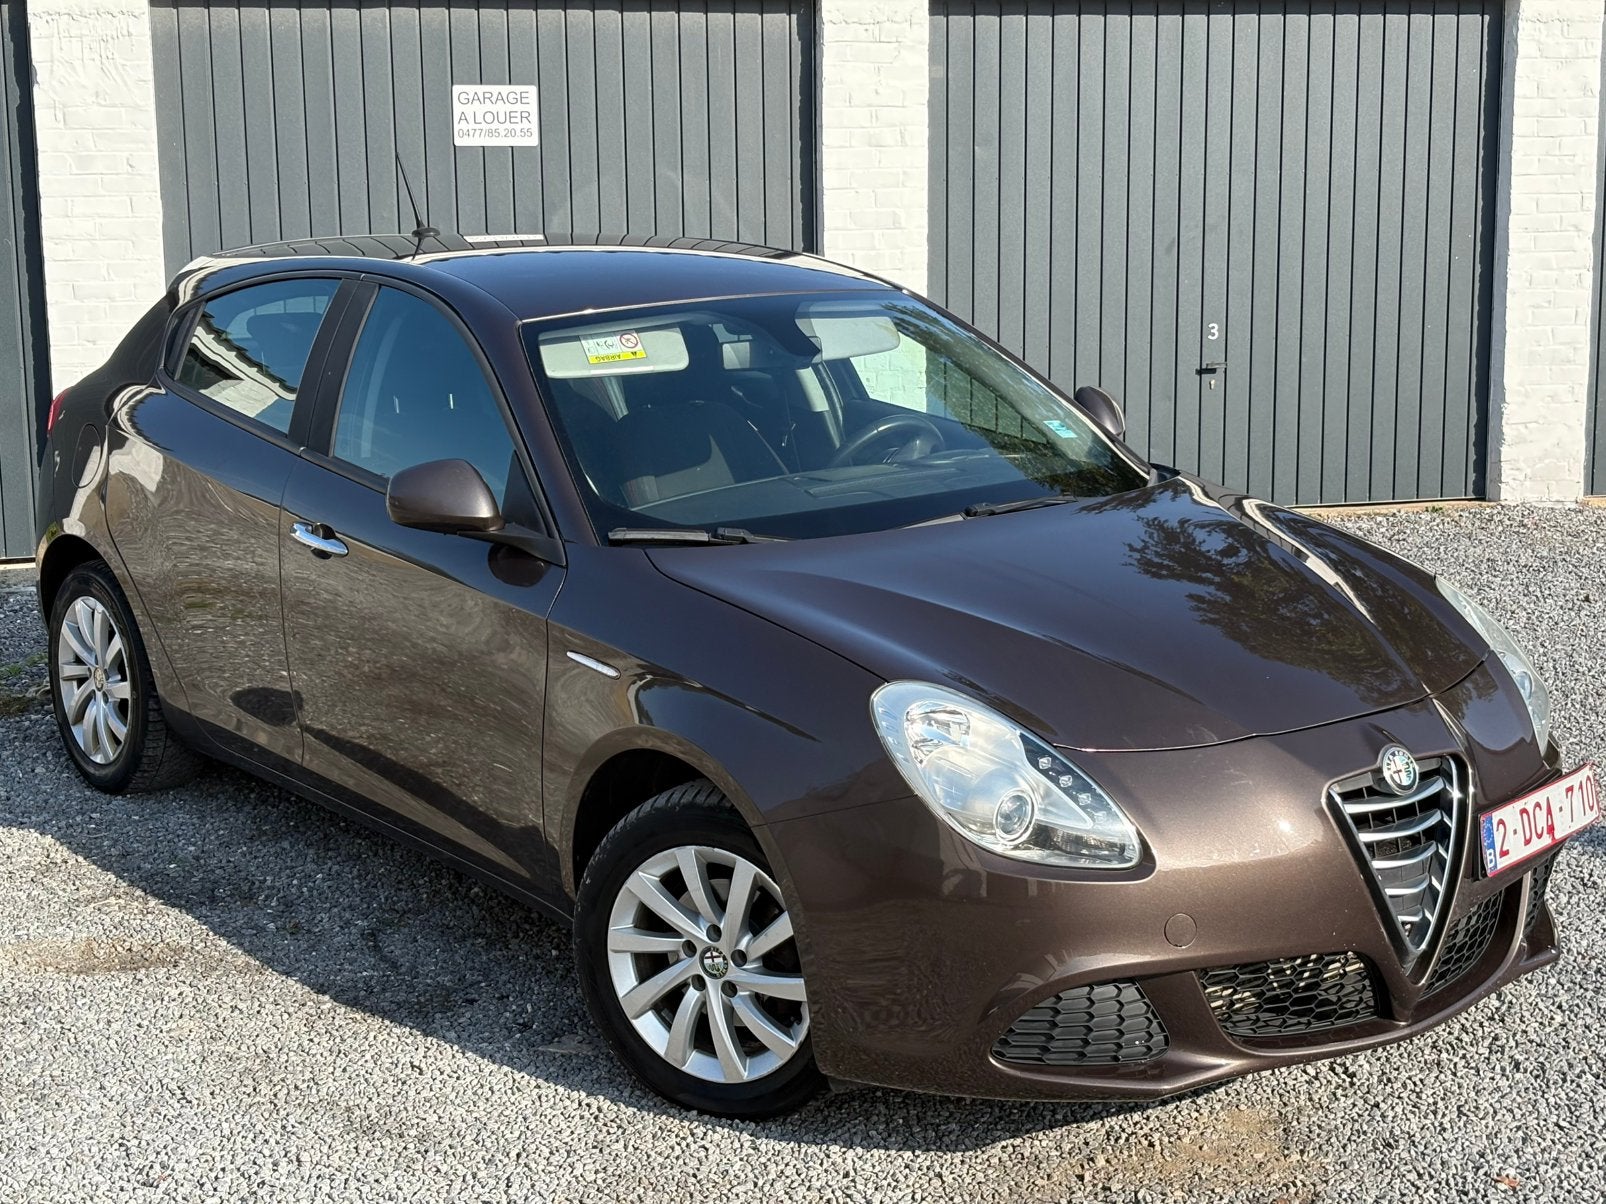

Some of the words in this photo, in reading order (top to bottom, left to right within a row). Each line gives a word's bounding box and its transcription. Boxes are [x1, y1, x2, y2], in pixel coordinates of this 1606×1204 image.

[457, 91, 530, 105] GARAGE
[458, 111, 469, 124] A
[473, 110, 532, 124] LOUER
[457, 128, 533, 138] 0477/85.20.55
[1207, 322, 1219, 340] 3
[1496, 775, 1595, 859] 2-DCA-710
[1486, 848, 1496, 868] B
